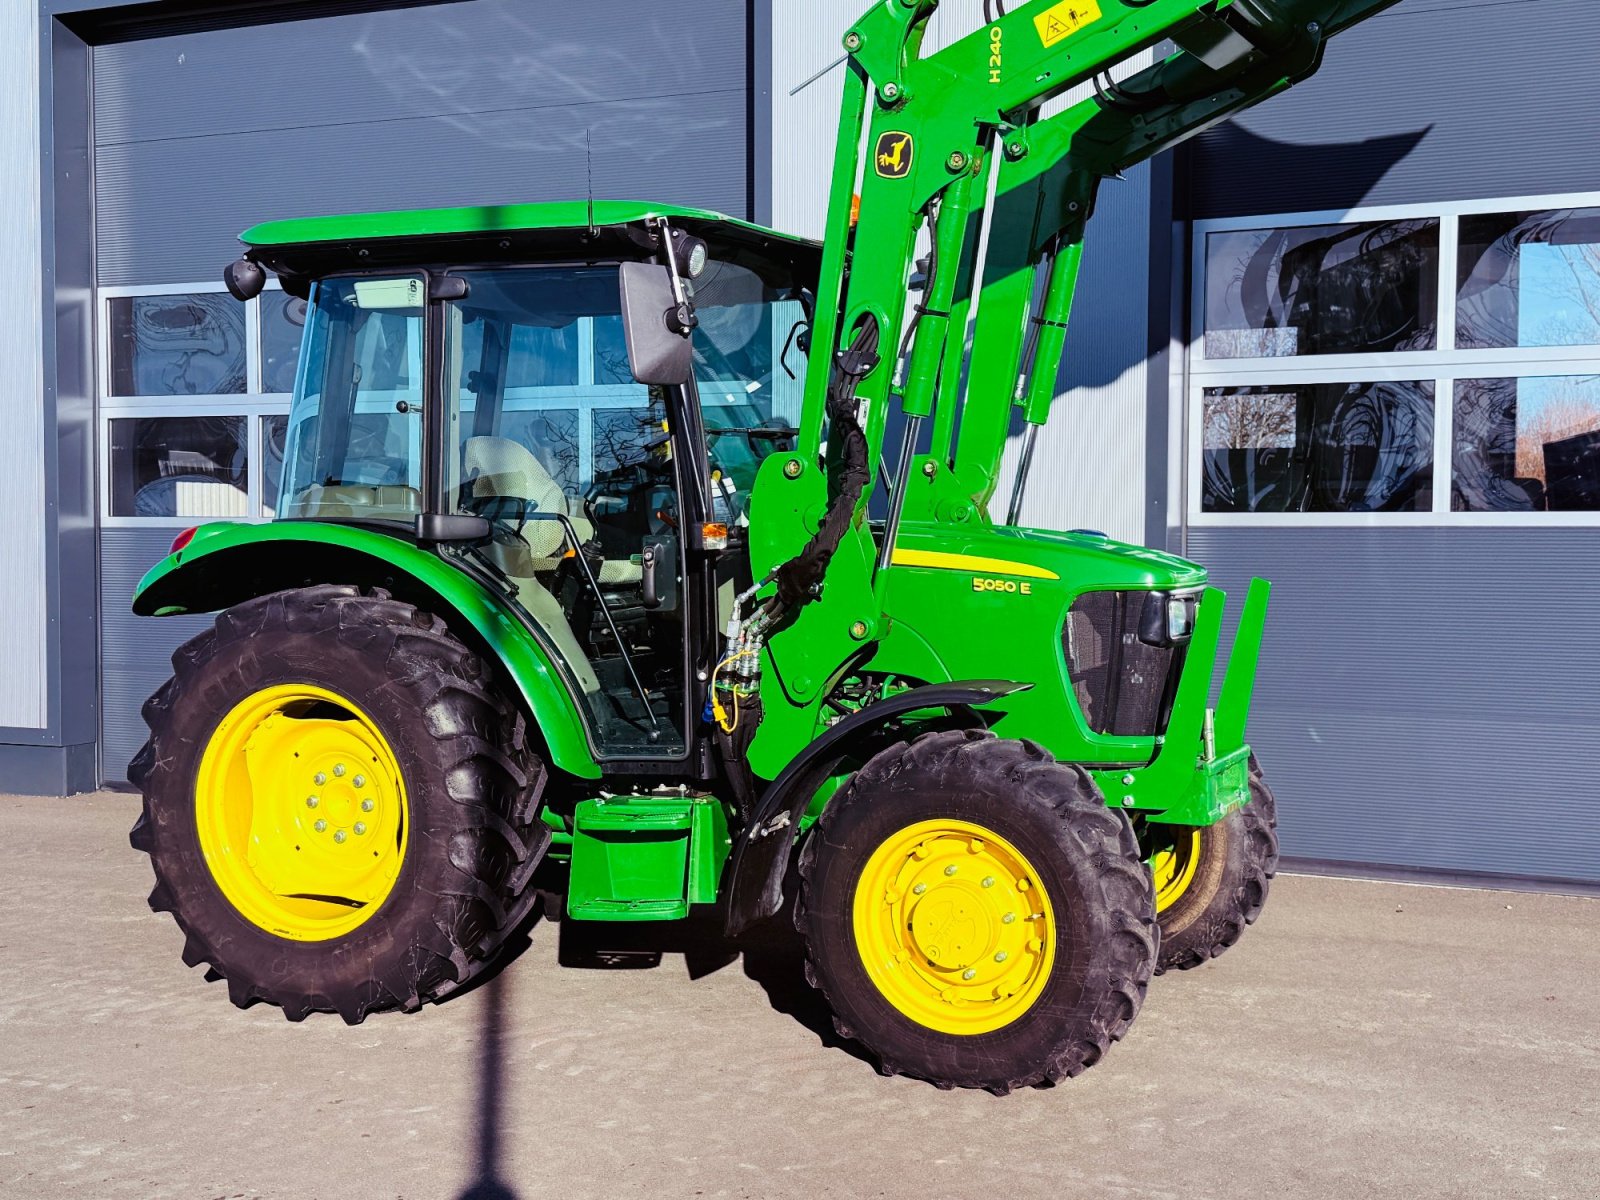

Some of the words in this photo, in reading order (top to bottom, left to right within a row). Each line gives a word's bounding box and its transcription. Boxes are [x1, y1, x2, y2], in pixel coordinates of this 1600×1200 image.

[989, 26, 1002, 67] 240
[989, 69, 1001, 83] H
[972, 577, 1017, 593] 5050
[1020, 582, 1032, 595] E
